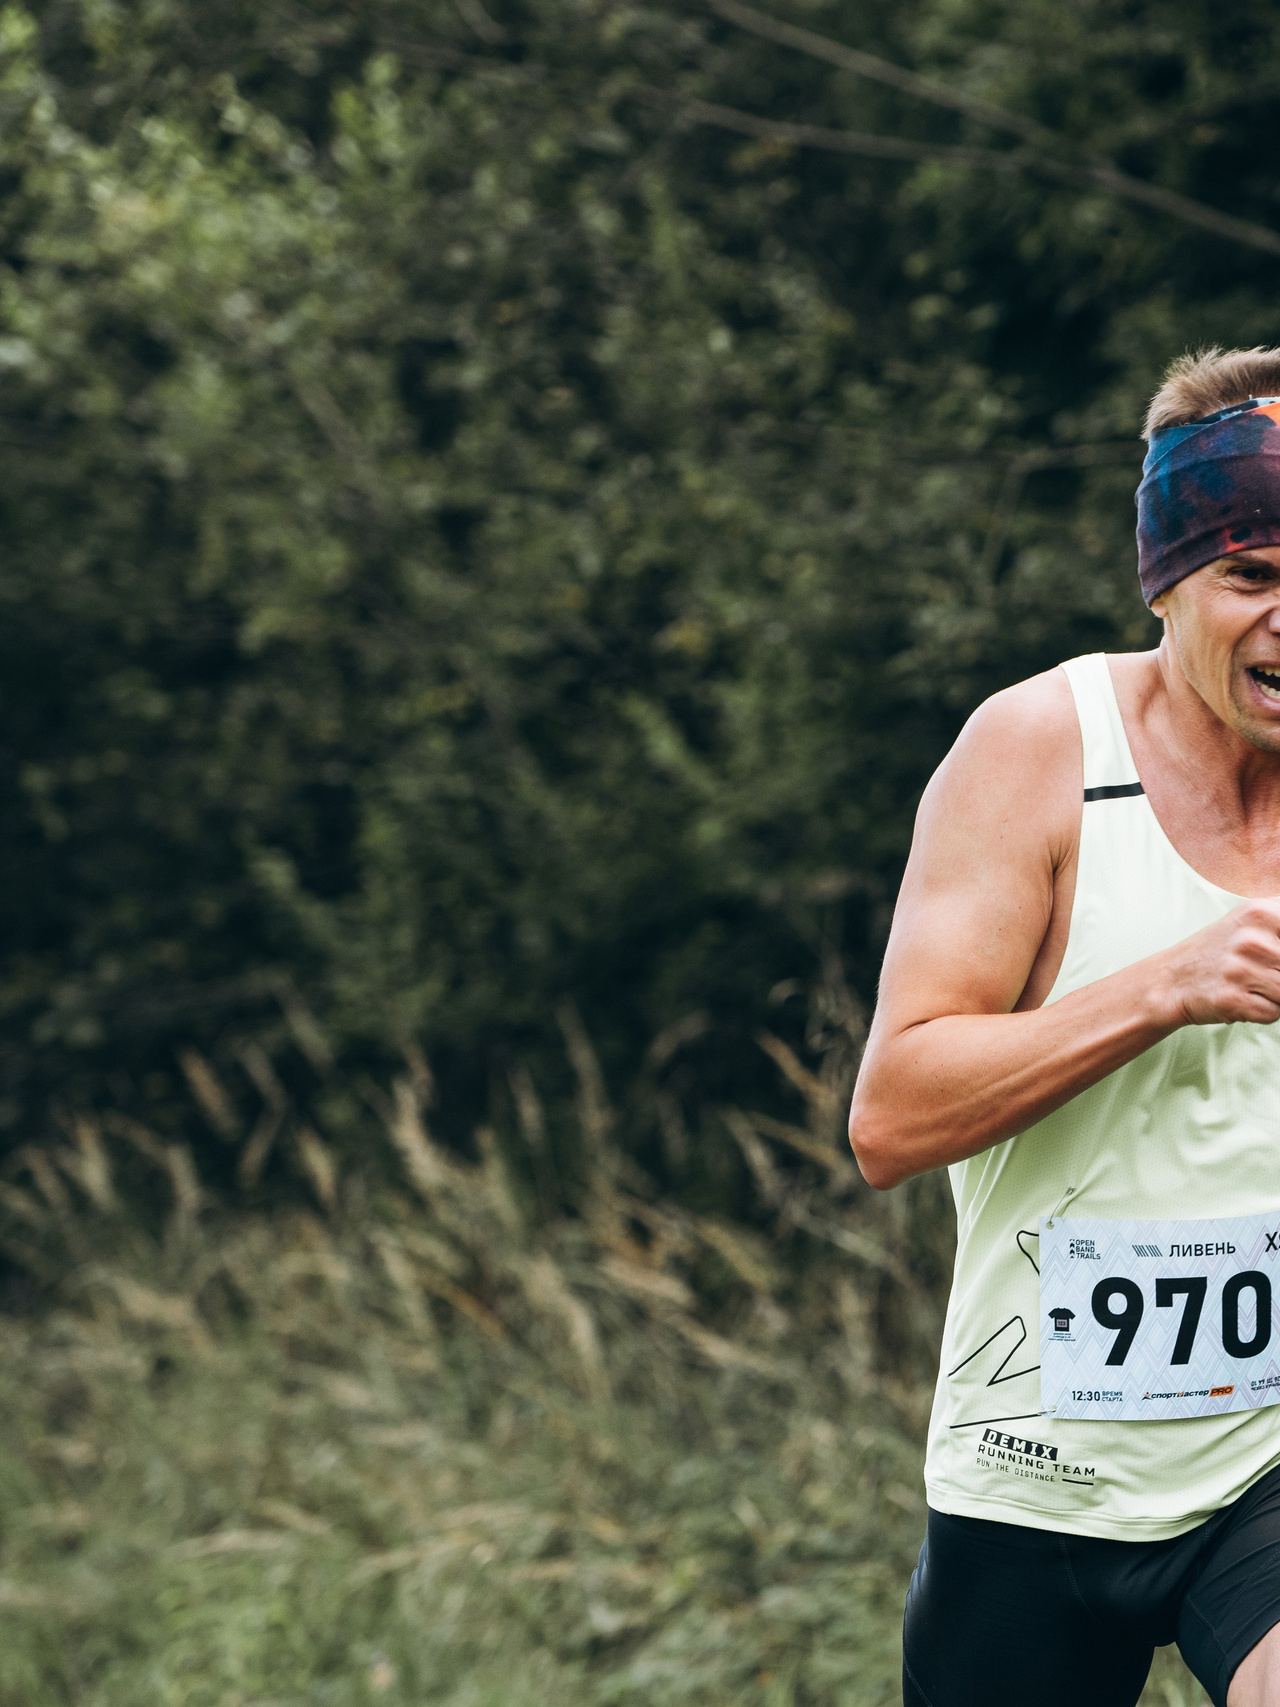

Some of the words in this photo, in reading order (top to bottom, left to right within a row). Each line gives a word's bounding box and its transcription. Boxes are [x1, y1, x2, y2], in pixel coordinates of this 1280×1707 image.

[1076, 1252, 1102, 1260] TRAILS
[1169, 1242, 1236, 1257] ЛИВЕНЬ
[1091, 1271, 1272, 1366] 970
[1071, 1390, 1101, 1402] 12:30
[1210, 1386, 1233, 1396] PRO
[986, 1430, 1053, 1460] DEMIX
[976, 1457, 991, 1468] RUN
[996, 1462, 1009, 1473] THE
[1014, 1467, 1055, 1482] DISTANCE
[978, 1444, 1045, 1470] RUNNING
[1053, 1463, 1096, 1477] TEAM
